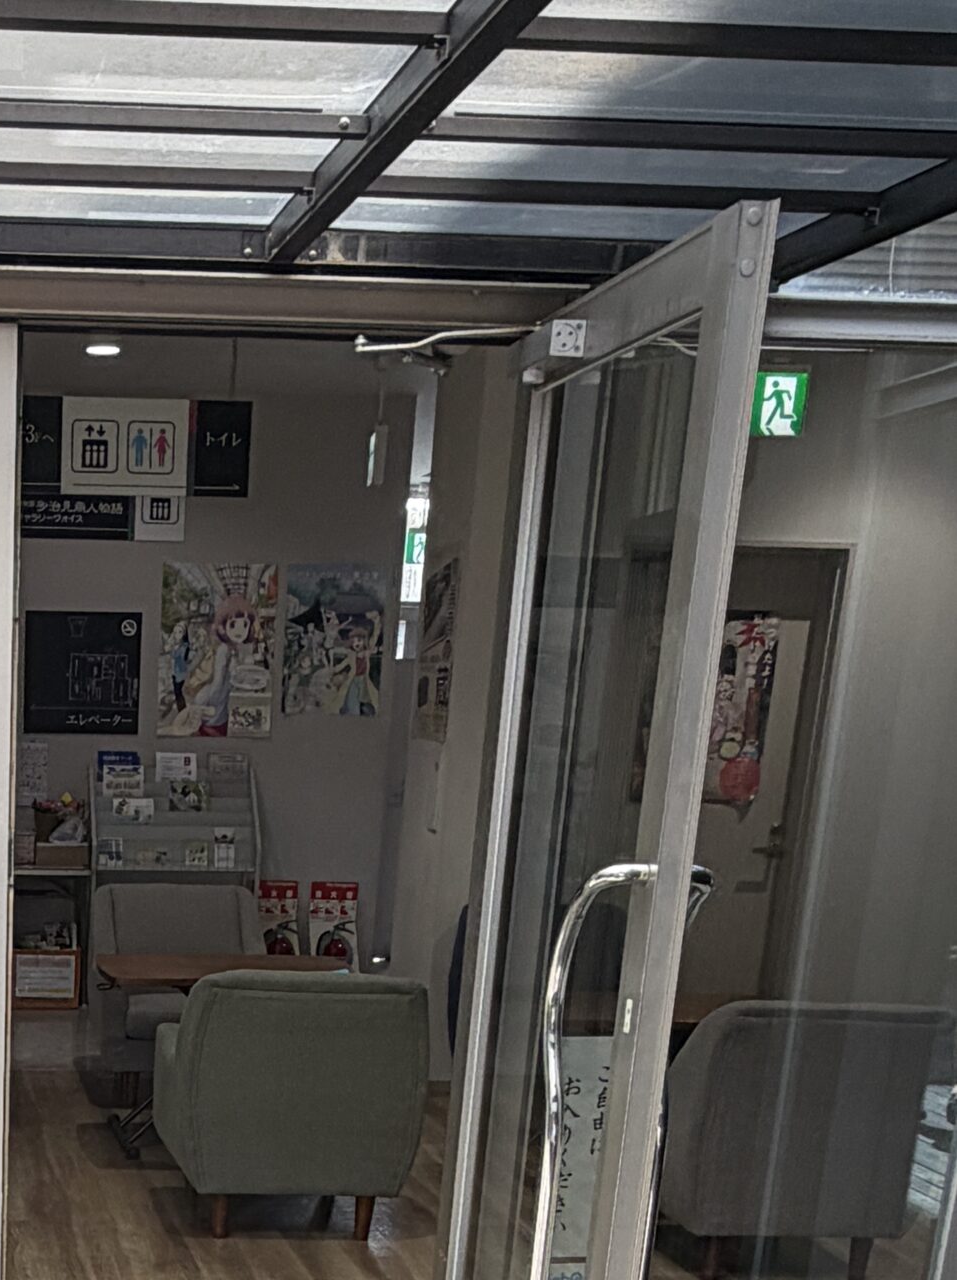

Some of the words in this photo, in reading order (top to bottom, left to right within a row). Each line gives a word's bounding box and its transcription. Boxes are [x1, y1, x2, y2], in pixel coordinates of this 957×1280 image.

[205, 431, 242, 448] トイレ
[66, 713, 133, 727] エレベーター
